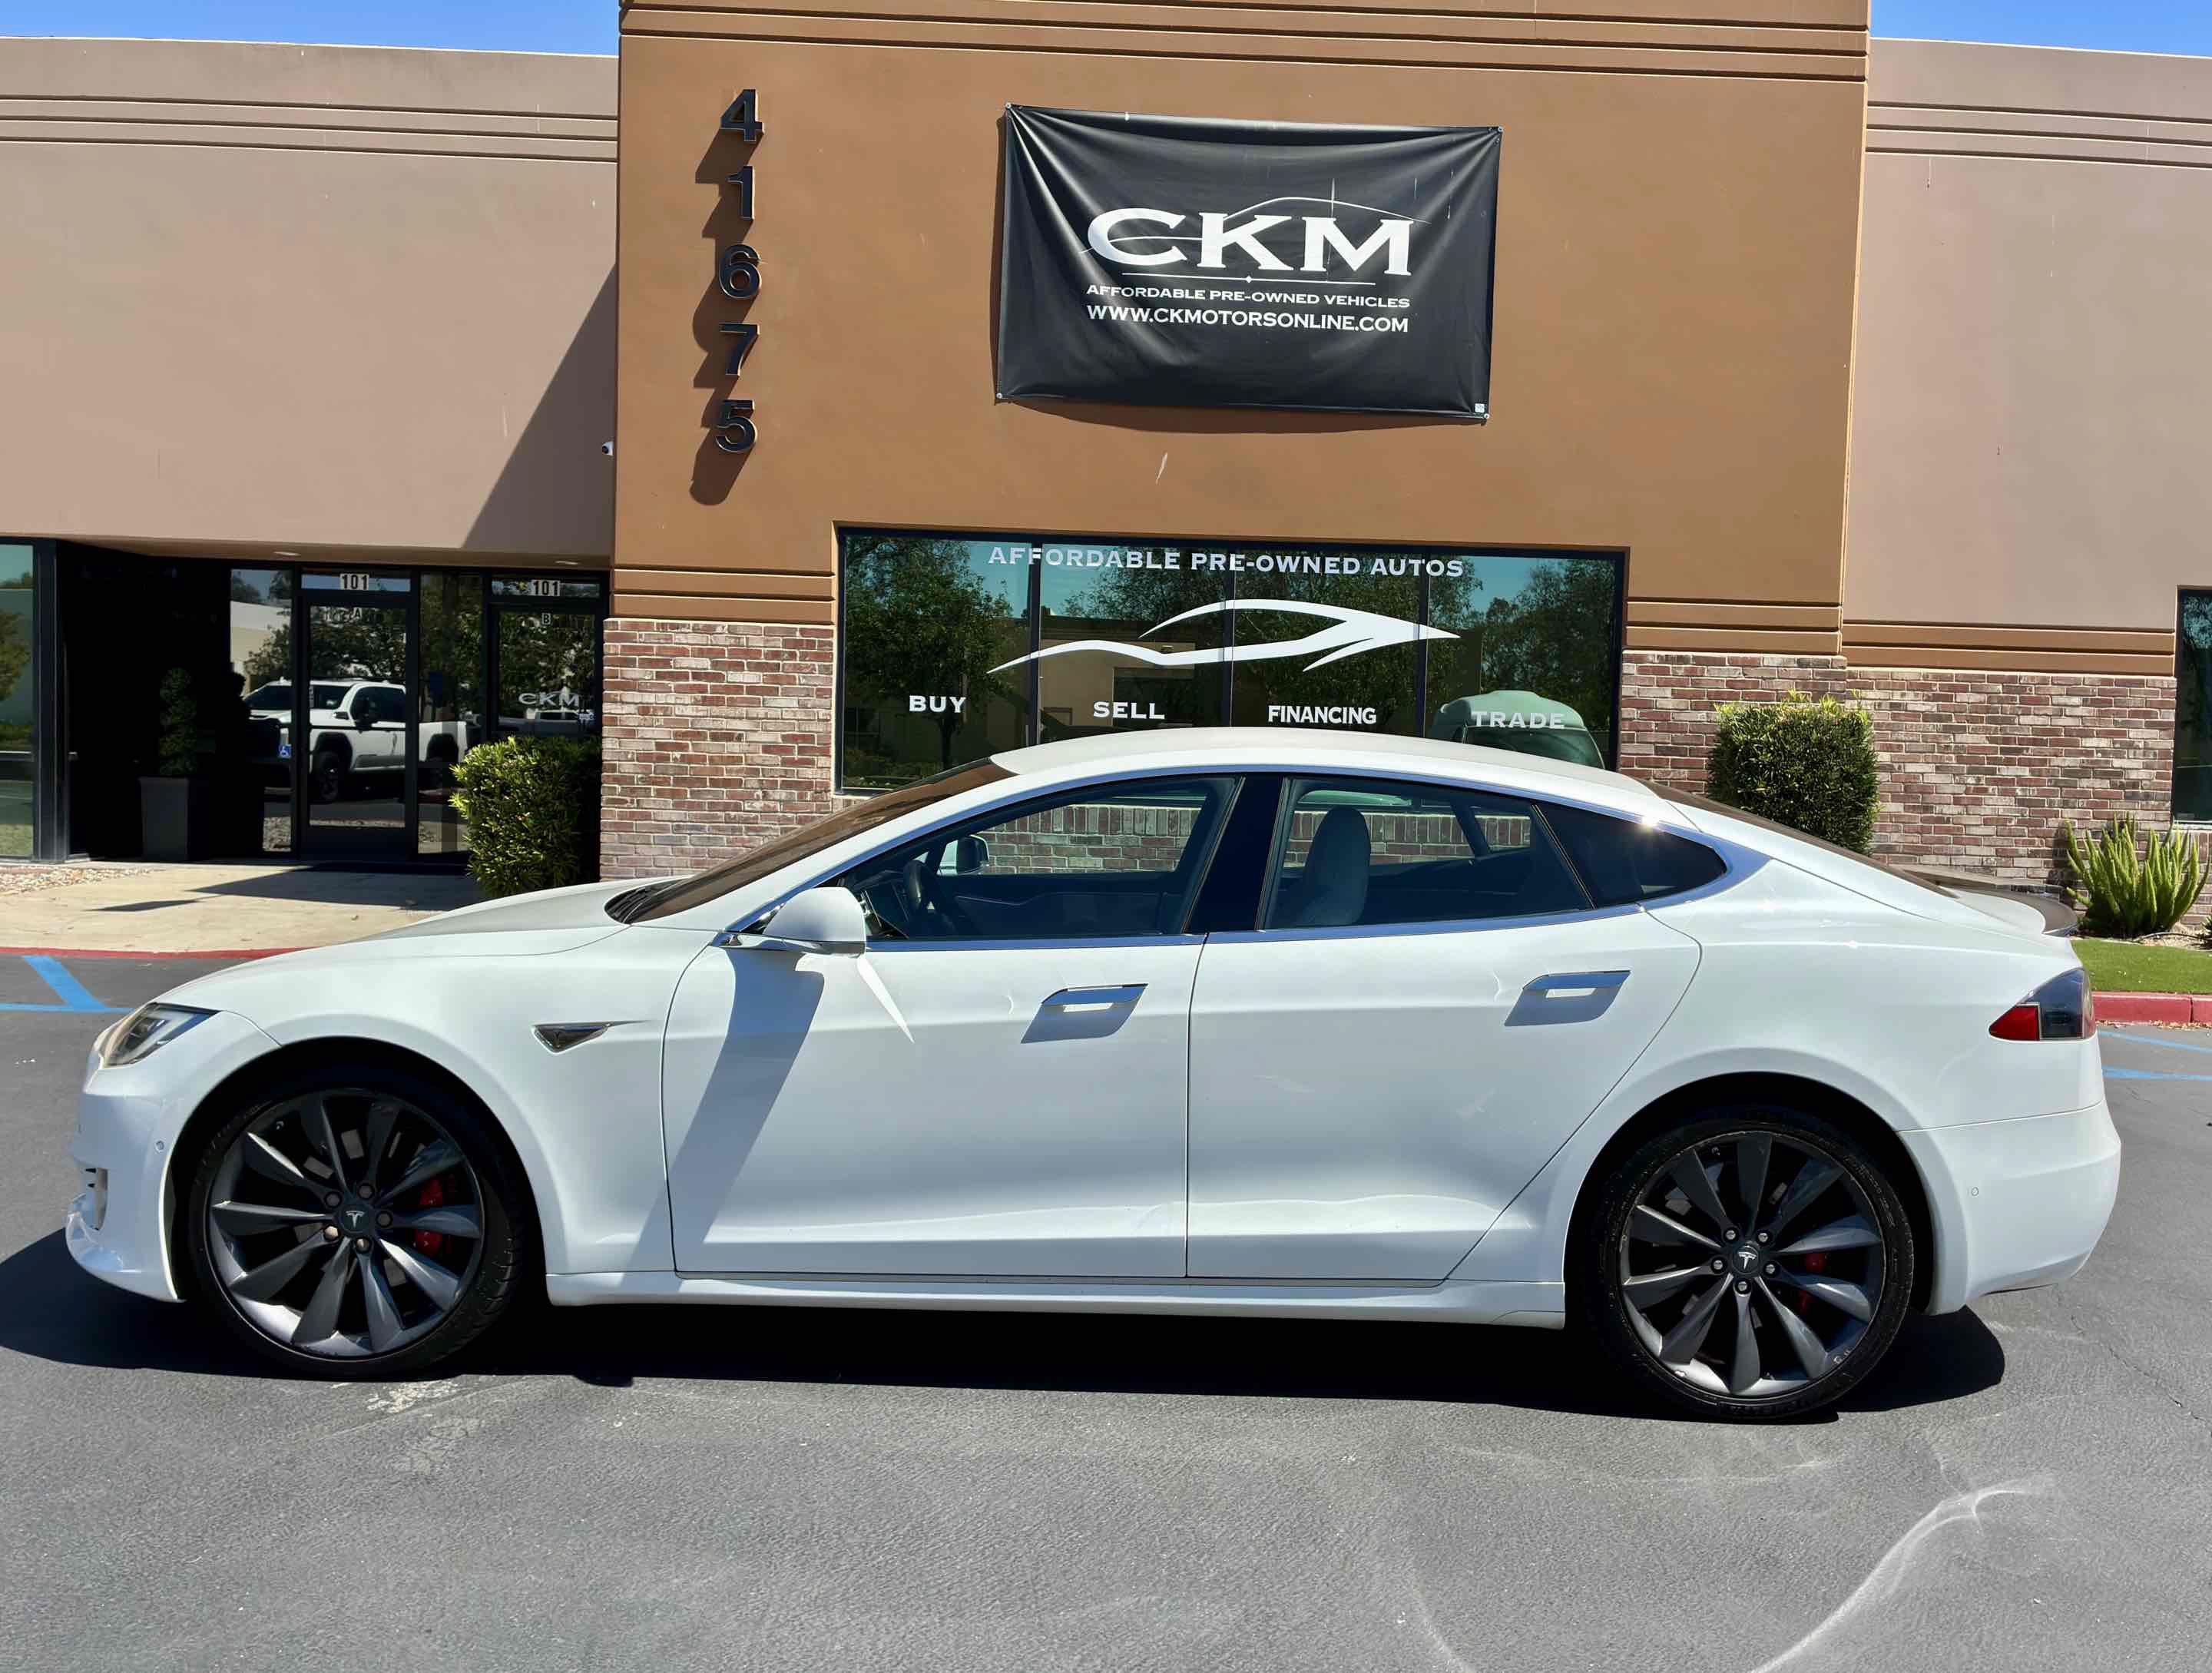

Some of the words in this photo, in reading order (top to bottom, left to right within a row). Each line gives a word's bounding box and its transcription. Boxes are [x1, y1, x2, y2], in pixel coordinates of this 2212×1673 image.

[1087, 207, 1416, 277] CKM
[1086, 284, 1206, 301] AFFORDABLE
[1209, 290, 1320, 305] PRE-OWNED
[1323, 294, 1411, 309] VEHICLES
[1086, 304, 1410, 333] WWW.CKMOTORSONLINE.COM
[988, 546, 1181, 570] AFFORDABLE
[1190, 552, 1360, 575] PRE-OWNED
[1370, 558, 1464, 578] AUTOS
[342, 575, 368, 590] 101
[533, 581, 559, 596] 101
[542, 614, 551, 624] B
[518, 693, 580, 707] CKM
[909, 695, 967, 714] BUY
[1093, 701, 1166, 721] SELL
[1267, 704, 1377, 726] FINANCING
[1471, 711, 1565, 729] TRADE
